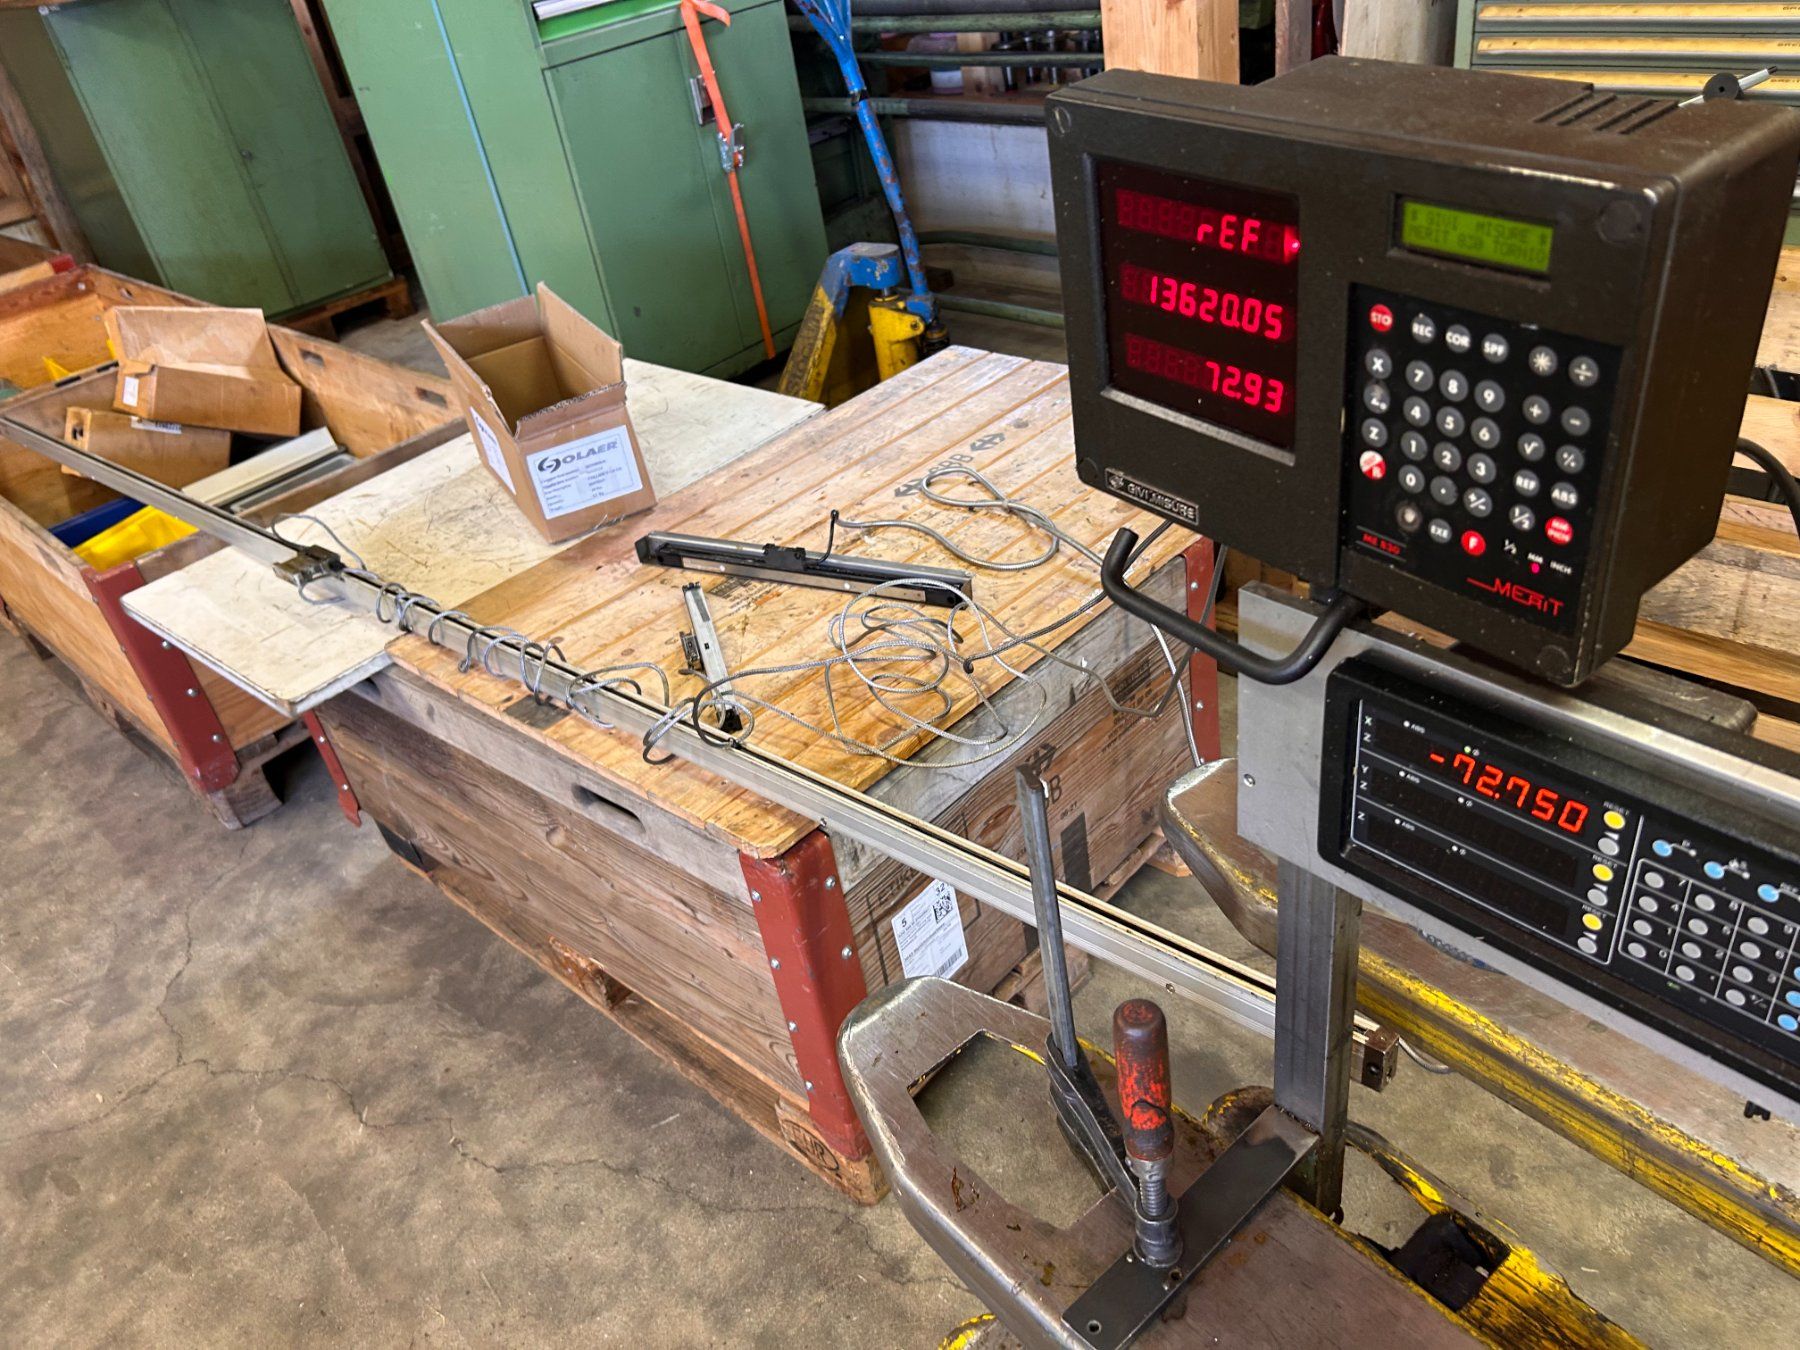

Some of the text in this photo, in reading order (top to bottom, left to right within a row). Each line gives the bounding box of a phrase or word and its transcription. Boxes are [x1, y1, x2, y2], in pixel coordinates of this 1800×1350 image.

[1412, 322, 1433, 338] REC
[1372, 357, 1384, 373] X
[1414, 368, 1425, 383] 7
[1447, 378, 1459, 395] 8
[1483, 388, 1496, 404] 9
[1410, 405, 1421, 420] 4
[1444, 415, 1455, 430] 5
[1368, 426, 1380, 441] Z
[1478, 427, 1490, 442] 6
[1409, 440, 1417, 454] 1
[1441, 450, 1452, 465] 2
[1475, 462, 1487, 477] 3
[1405, 473, 1417, 487] 0
[1515, 475, 1536, 491] REF
[1551, 489, 1578, 505] ABS
[1468, 536, 1478, 550] F
[1364, 715, 1373, 726] X
[1363, 732, 1372, 743] Z
